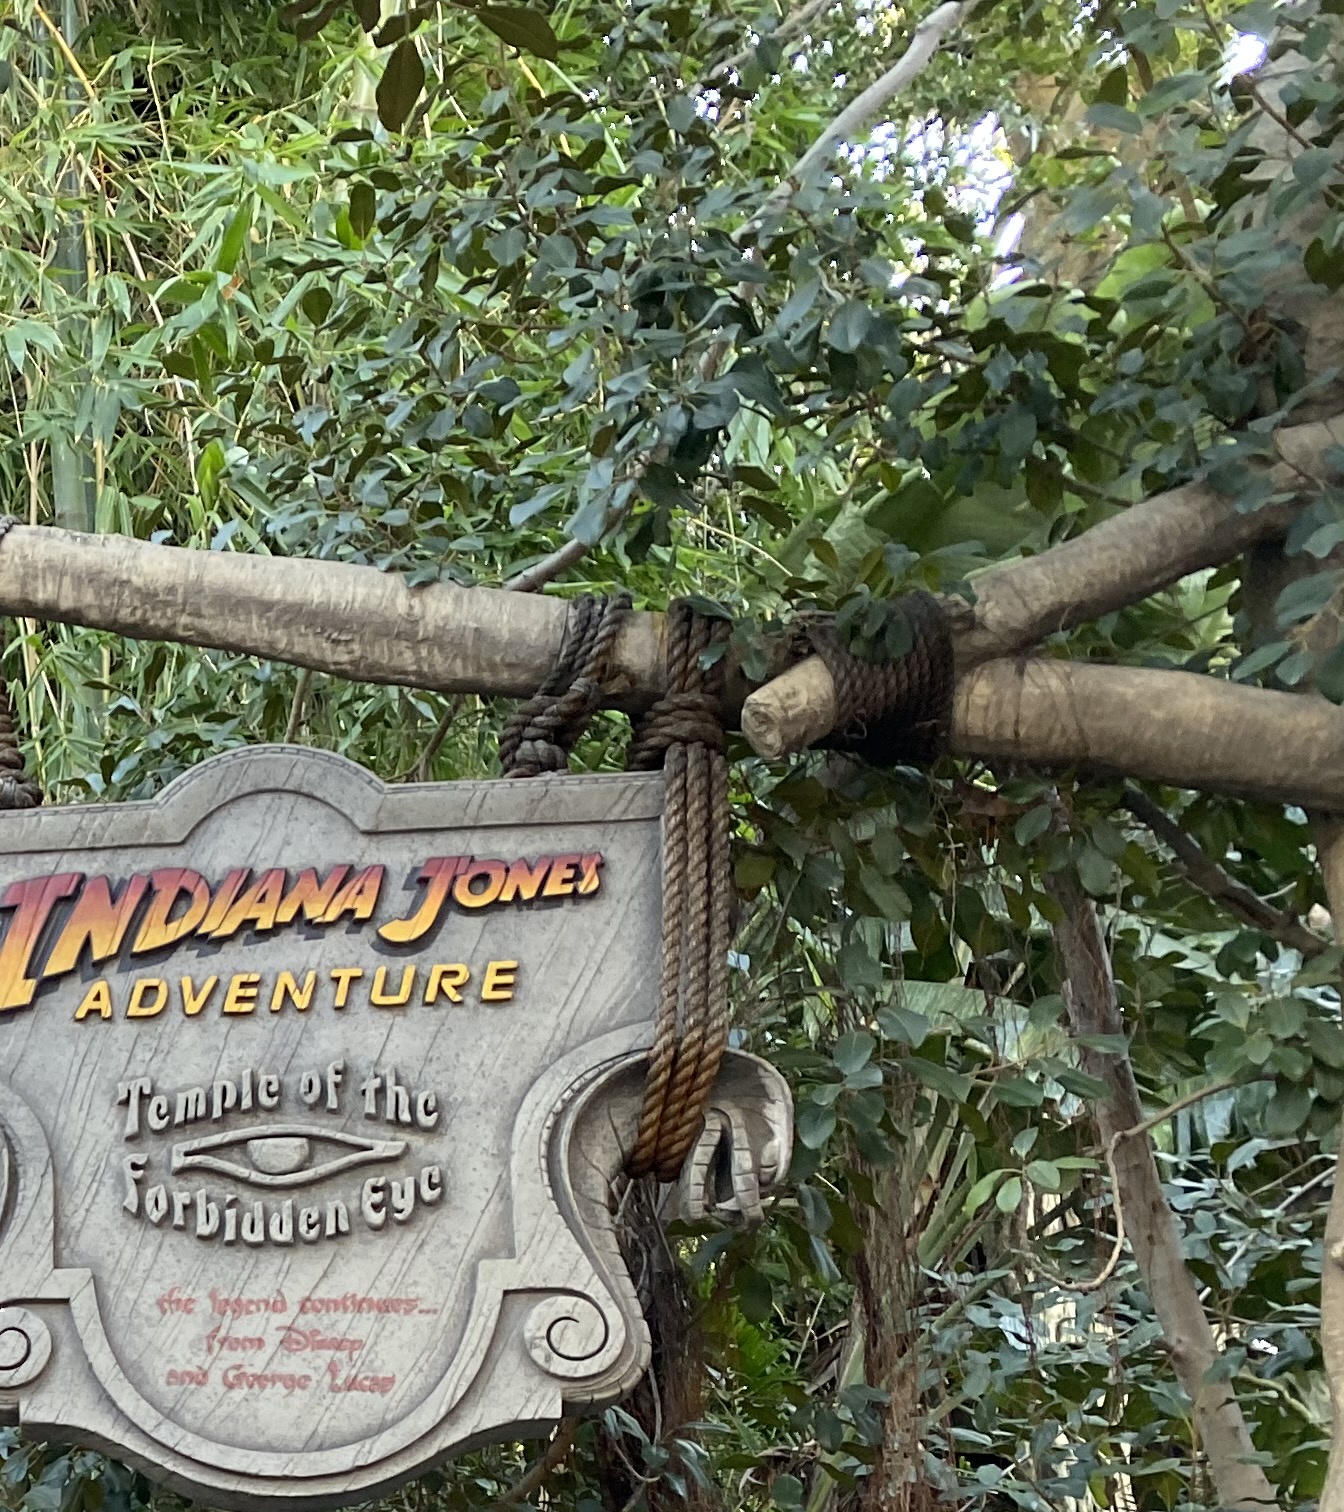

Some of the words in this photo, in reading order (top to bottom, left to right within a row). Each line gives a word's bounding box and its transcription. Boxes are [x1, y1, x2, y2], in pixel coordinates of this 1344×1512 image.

[377, 852, 607, 943] JONES
[74, 959, 519, 1021] ADVENTURE
[117, 1067, 281, 1141] Temple
[299, 1057, 347, 1112] of
[361, 1063, 440, 1129] the
[122, 1152, 350, 1246] Forbidden
[362, 1164, 444, 1230] Eye
[156, 1287, 197, 1315] the
[165, 1366, 208, 1387] and
